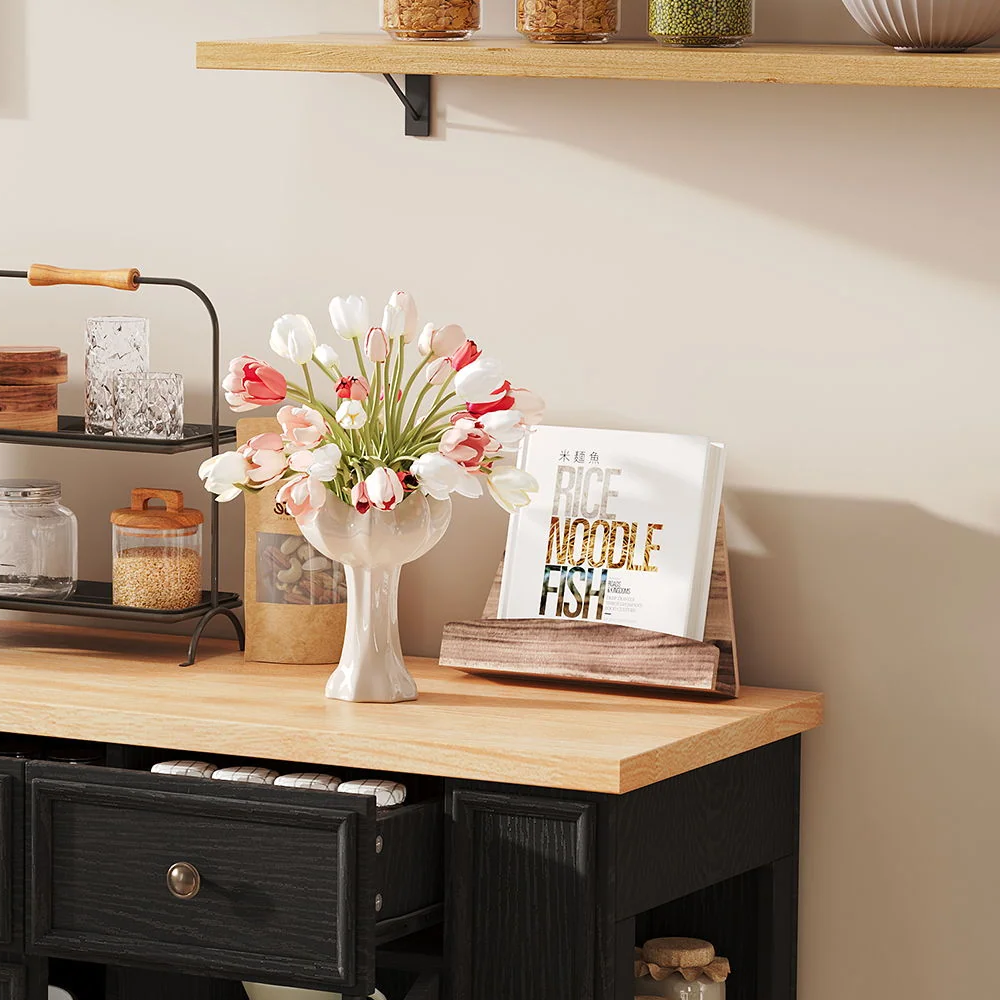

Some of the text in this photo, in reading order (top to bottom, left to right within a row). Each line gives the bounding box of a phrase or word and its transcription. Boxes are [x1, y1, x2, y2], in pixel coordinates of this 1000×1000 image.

[552, 465, 622, 520] RICE
[545, 516, 664, 572] NOODLE
[539, 564, 609, 620] FISH
